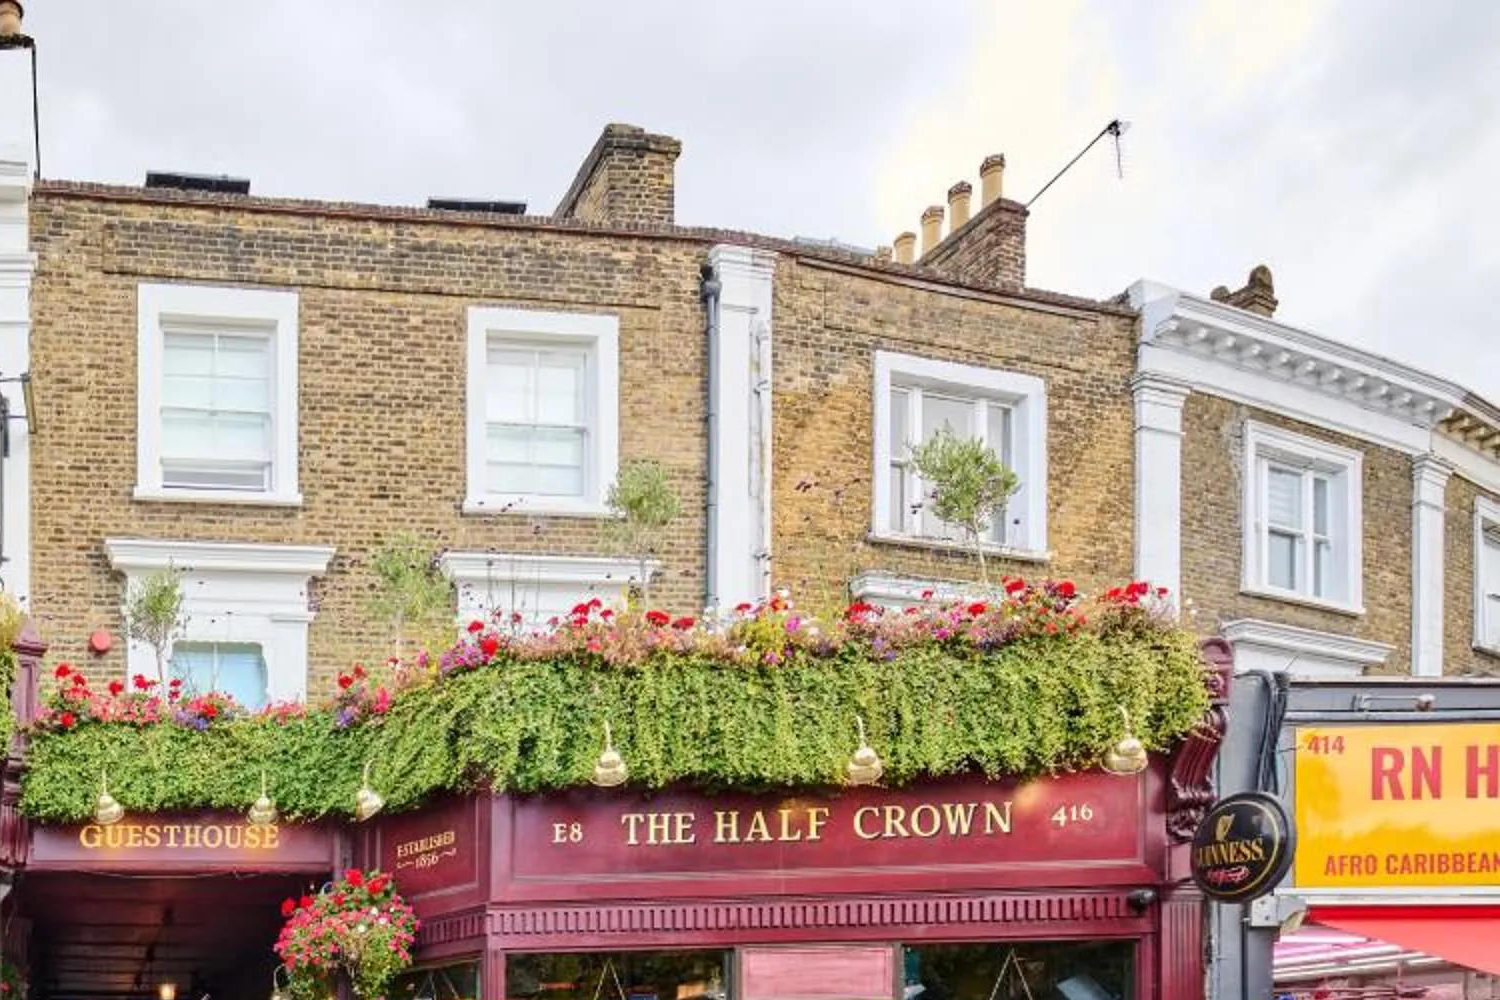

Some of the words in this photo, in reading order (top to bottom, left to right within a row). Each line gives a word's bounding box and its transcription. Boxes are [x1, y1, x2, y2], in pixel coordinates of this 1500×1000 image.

[1307, 735, 1345, 755] 414
[1371, 745, 1442, 801] RN
[79, 823, 280, 849] GUESTHOUSE
[553, 822, 584, 844] E8
[620, 811, 697, 846] THE
[711, 806, 830, 844] HALF
[852, 801, 1014, 840] CROWN
[1051, 803, 1094, 828] 416
[396, 831, 455, 858] ESTABLISHED
[1324, 854, 1378, 877] AFRO
